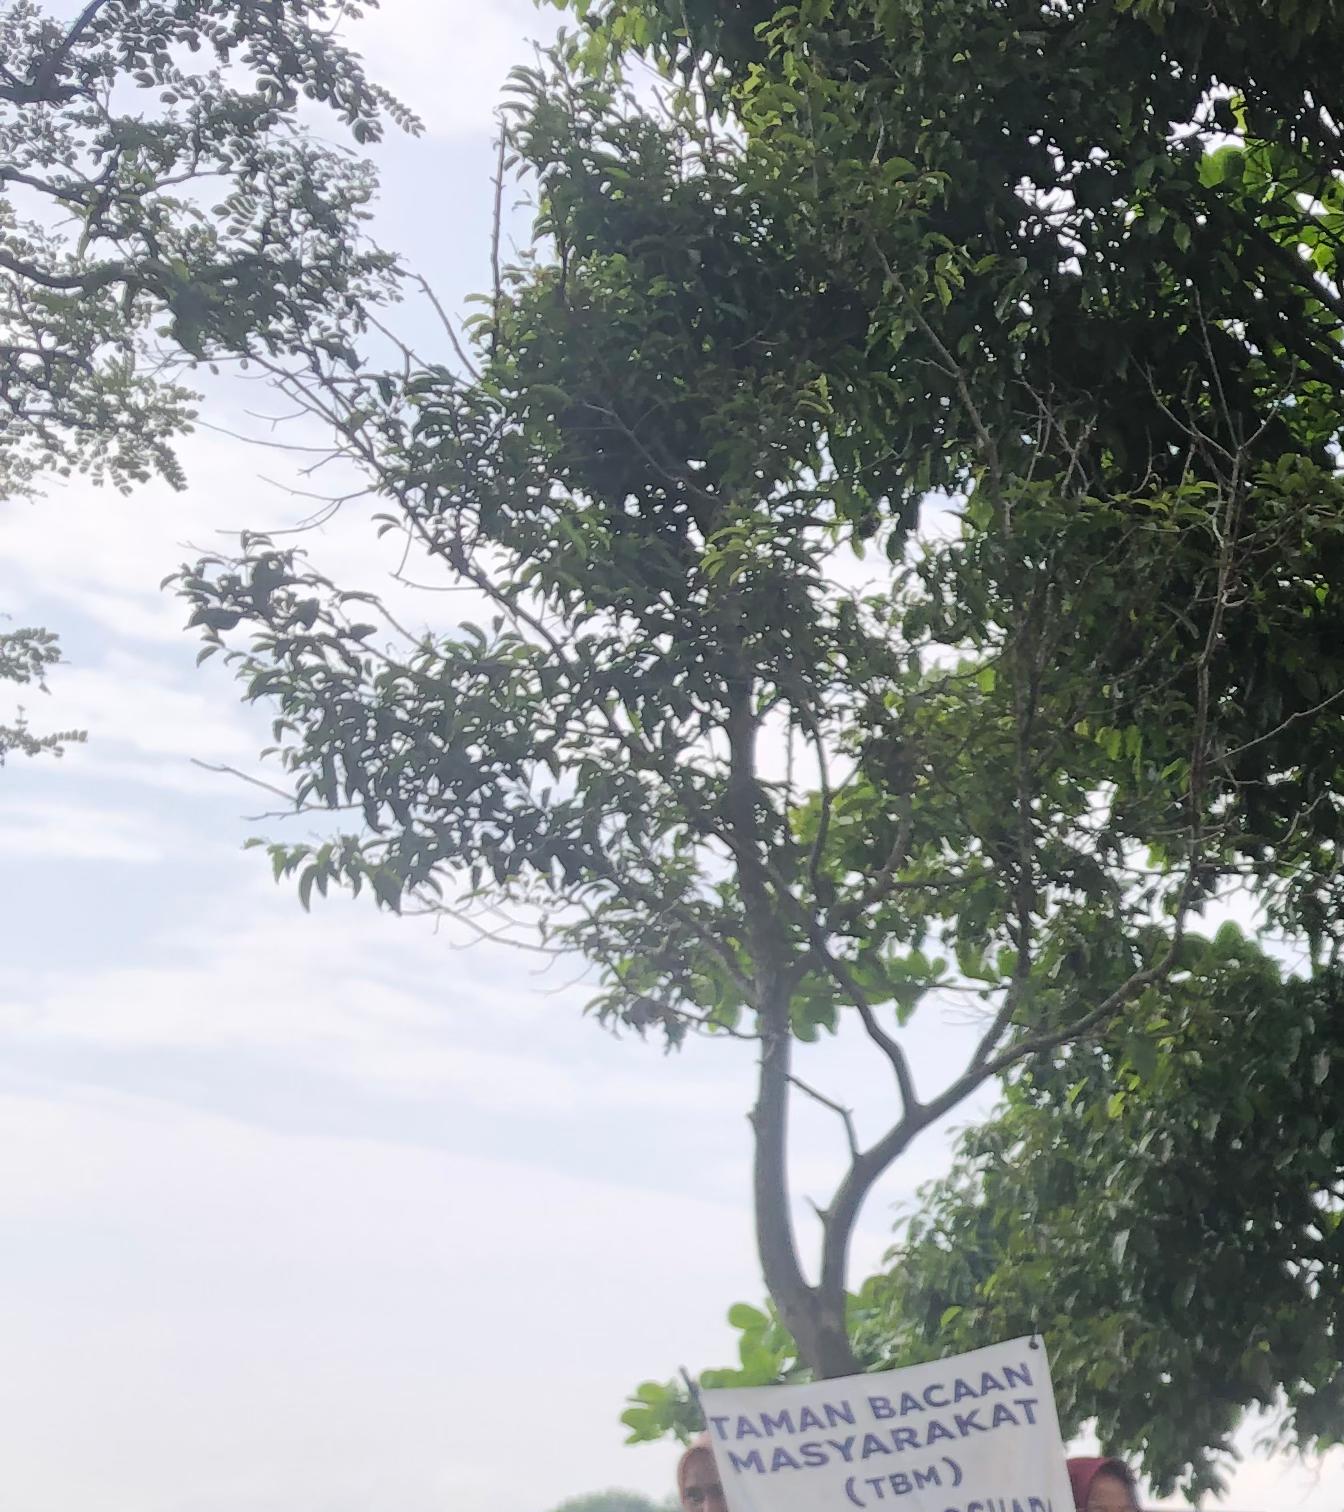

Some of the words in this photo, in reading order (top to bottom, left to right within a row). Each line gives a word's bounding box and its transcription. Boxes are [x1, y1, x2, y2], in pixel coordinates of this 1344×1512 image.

[709, 1399, 856, 1441] TAMAN
[867, 1361, 1034, 1420] BACAAN
[727, 1398, 1039, 1475] MASYARAKAT
[844, 1456, 963, 1508] (TBM)
